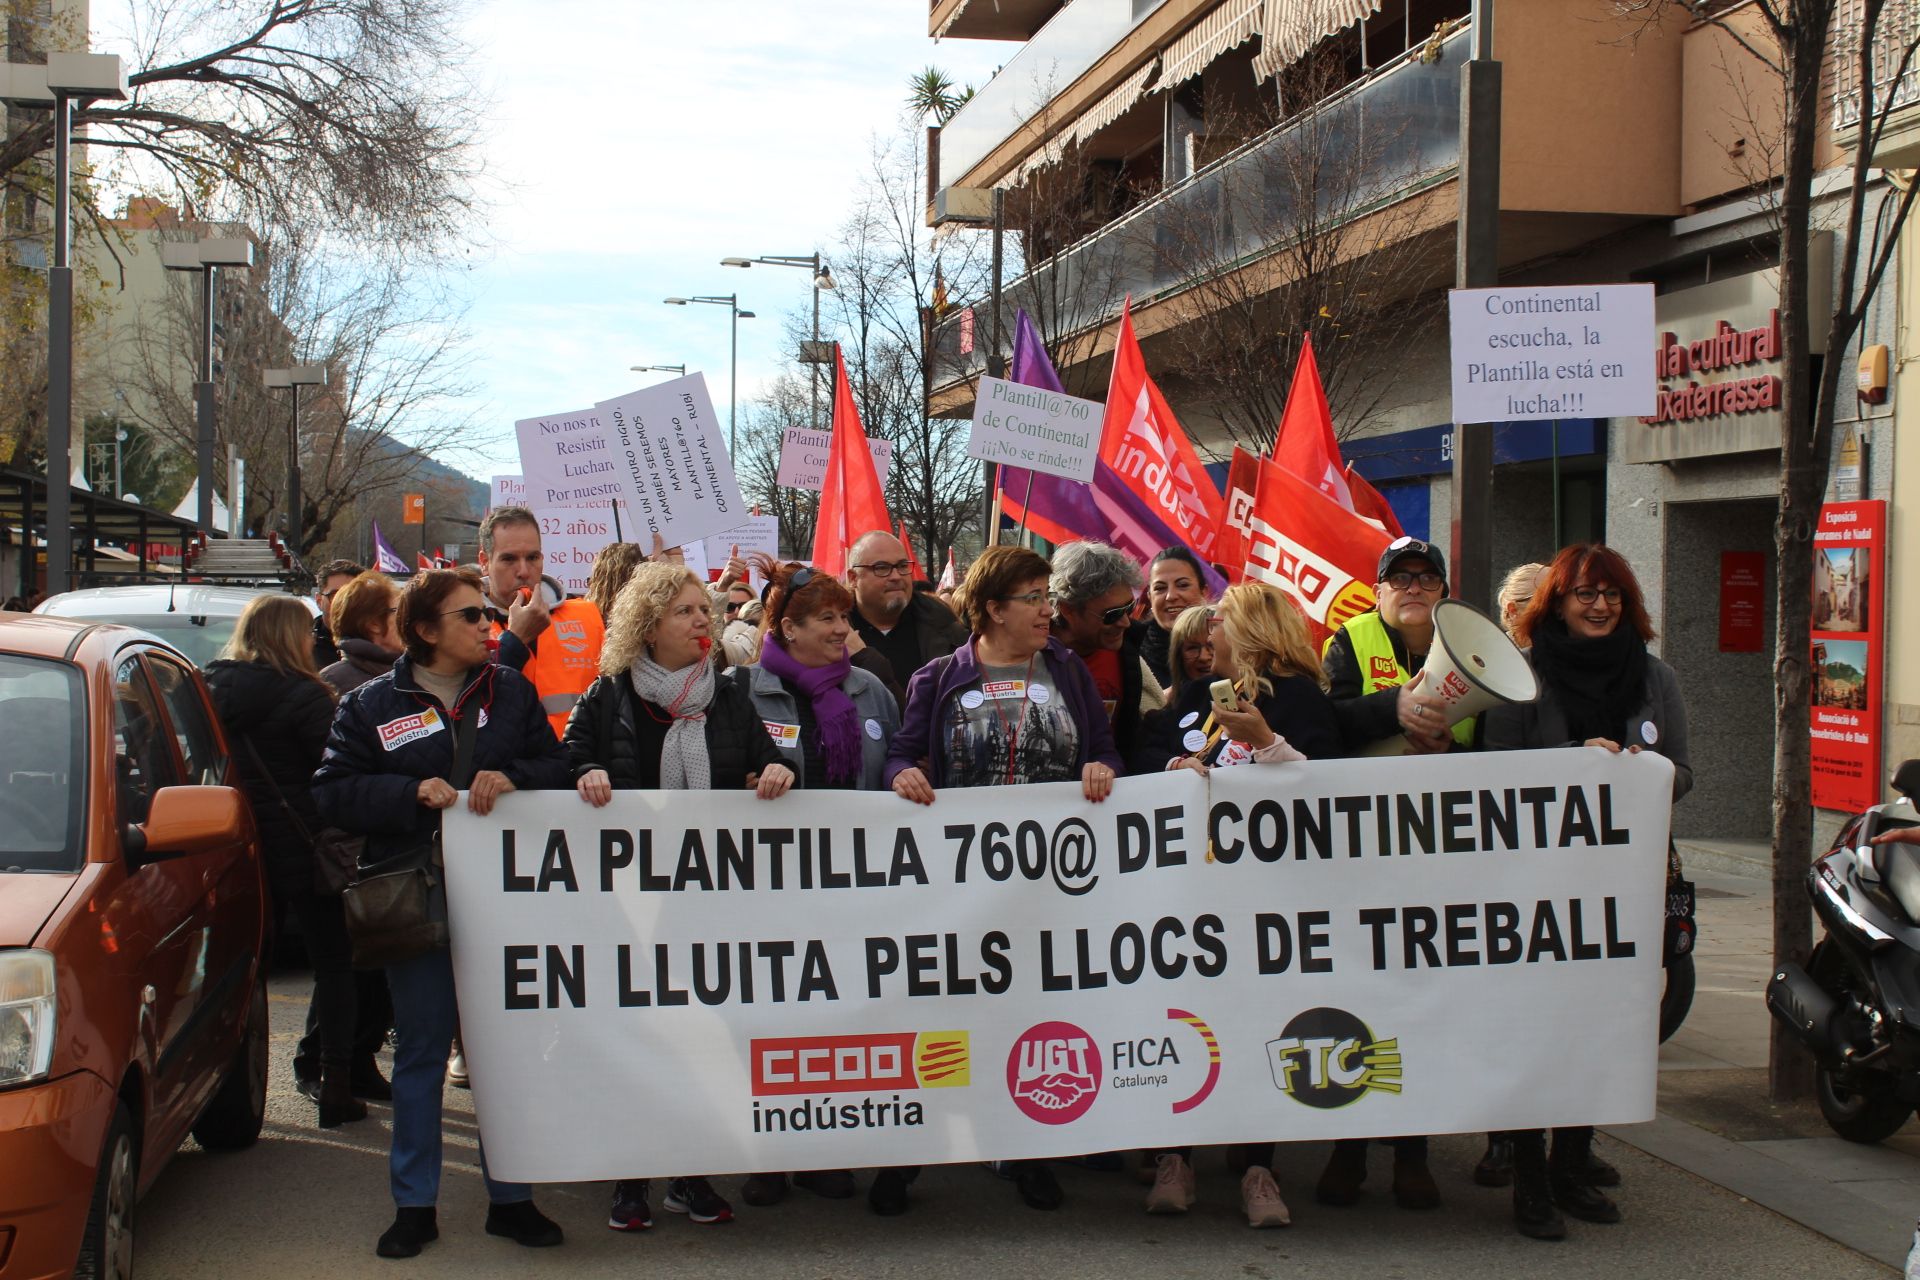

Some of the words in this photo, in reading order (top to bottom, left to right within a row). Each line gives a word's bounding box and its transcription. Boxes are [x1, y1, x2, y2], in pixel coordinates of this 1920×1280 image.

[1485, 292, 1601, 315] Continental
[1488, 327, 1573, 348] escucha,
[1583, 326, 1600, 345] la
[1688, 308, 1778, 371] cultural
[1468, 361, 1550, 383] Plantilla
[1556, 359, 1593, 379] está
[1600, 363, 1624, 378] en
[680, 393, 698, 420] RUBÍ
[992, 383, 1089, 420] Plantill@760
[1508, 393, 1584, 415] lucha!!!
[1638, 374, 1778, 424] ixaterrassa
[539, 421, 560, 436] No
[563, 419, 587, 432] nos
[613, 407, 631, 447] DIGNO,
[982, 410, 1000, 428] de
[1005, 415, 1089, 449] Continental
[633, 415, 657, 469] SEREMOS
[874, 445, 887, 457] de
[658, 436, 682, 491] MAYORES
[671, 417, 704, 500] PLANTILL@760
[1021, 449, 1035, 461] se
[1038, 450, 1082, 472] rinde!!!
[626, 450, 647, 494] FUTURO
[697, 434, 728, 513] CONTINENTAL
[546, 488, 570, 502] Por
[573, 482, 622, 499] nuestro
[651, 472, 673, 524] TAMBIÉN
[640, 498, 652, 513] UN
[1826, 510, 1857, 525] Exposició
[541, 518, 561, 535] 32
[566, 518, 607, 535] años
[1814, 529, 1843, 541] iorames
[1843, 528, 1852, 540] de
[1853, 527, 1872, 540] Nadal
[550, 551, 567, 564] se
[572, 546, 598, 564] bo
[986, 683, 1012, 692] CCOO
[1450, 674, 1470, 693] UGT
[384, 718, 421, 738] CCOO
[385, 728, 430, 750] indústria
[502, 828, 580, 893] LA
[600, 827, 930, 893] PLANTILLA
[944, 816, 1099, 896] 760@
[1117, 805, 1187, 874] DE
[1209, 784, 1630, 864] CONTINENTAL
[504, 944, 587, 1010] EN
[617, 940, 839, 1008] LLUITA
[865, 931, 1013, 998] PELS
[1040, 913, 1227, 991] LLOCS
[1255, 911, 1333, 975] DE
[1360, 897, 1636, 970] TREBALL
[762, 1045, 902, 1084] CCOO
[1018, 1038, 1089, 1077] UGT
[1113, 1037, 1180, 1070] FICA
[1112, 1073, 1168, 1089] Catalunya
[753, 1095, 924, 1132] indústria
